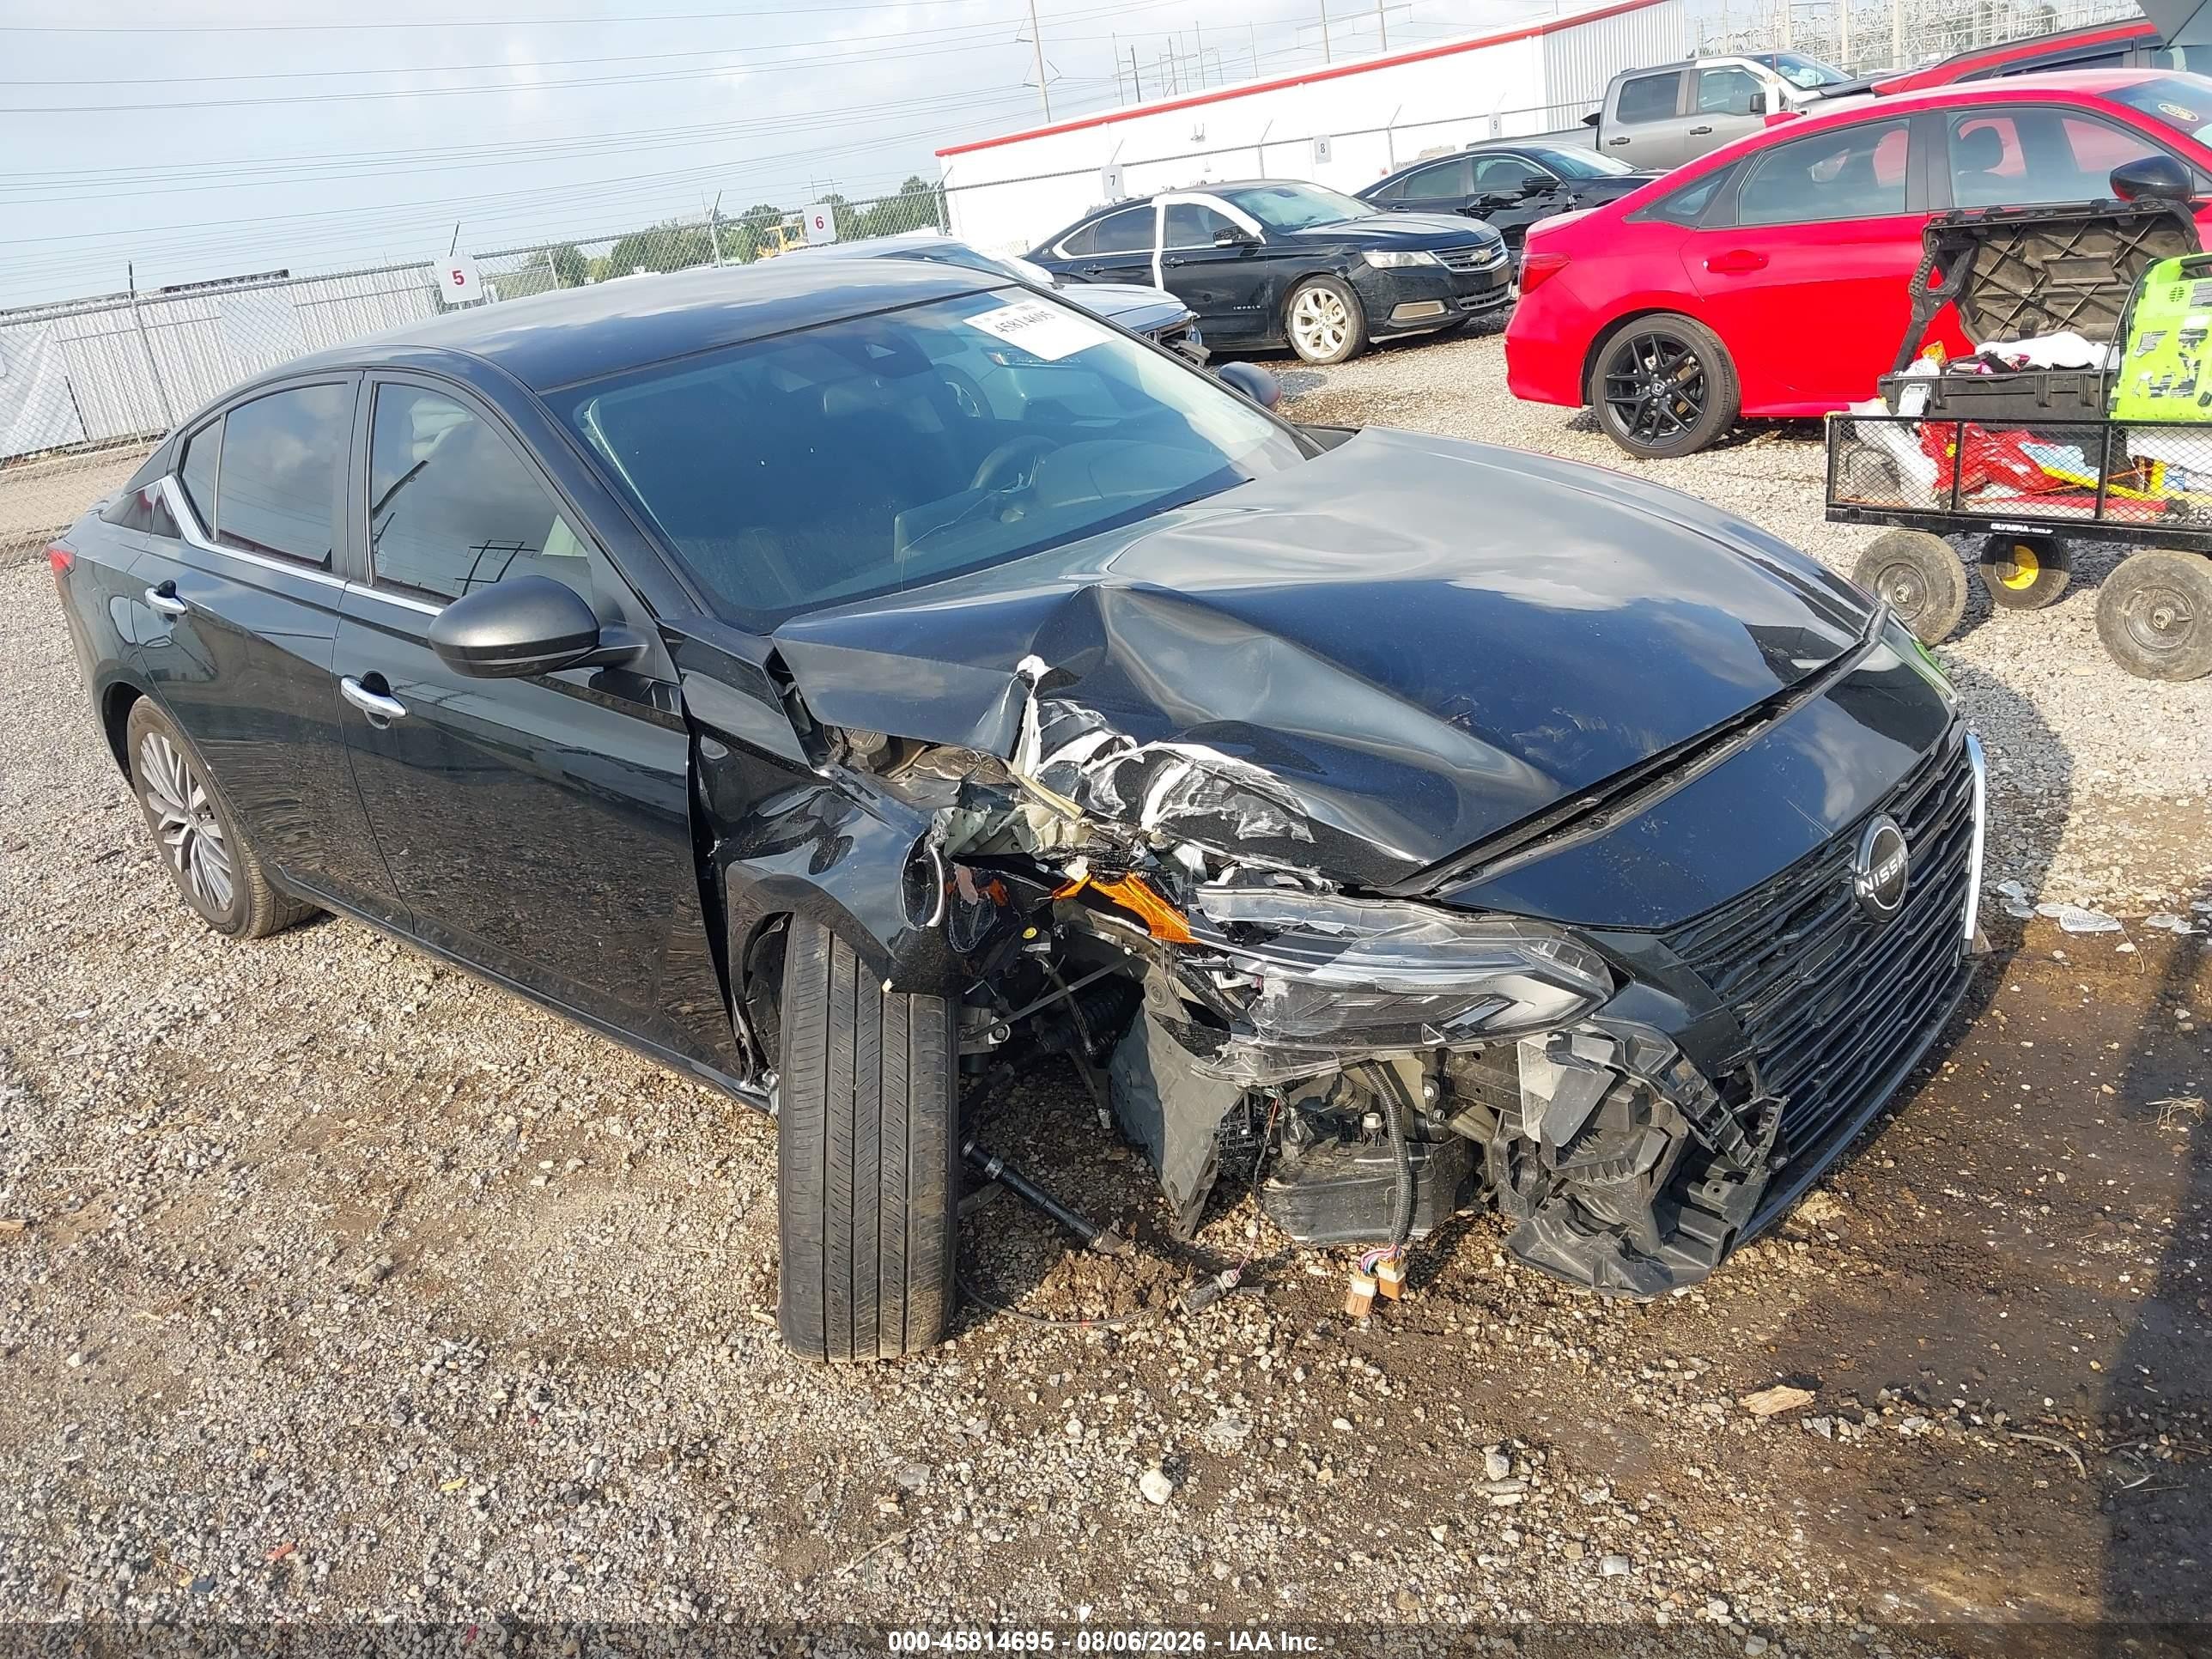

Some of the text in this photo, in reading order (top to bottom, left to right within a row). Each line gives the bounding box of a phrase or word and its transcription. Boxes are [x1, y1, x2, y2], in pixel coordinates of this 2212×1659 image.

[1493, 119, 1498, 130] 9
[1320, 143, 1326, 154] 8
[1109, 174, 1116, 186] 7
[816, 216, 824, 229] 6
[452, 270, 465, 286] 5
[994, 310, 1056, 333] 45814695
